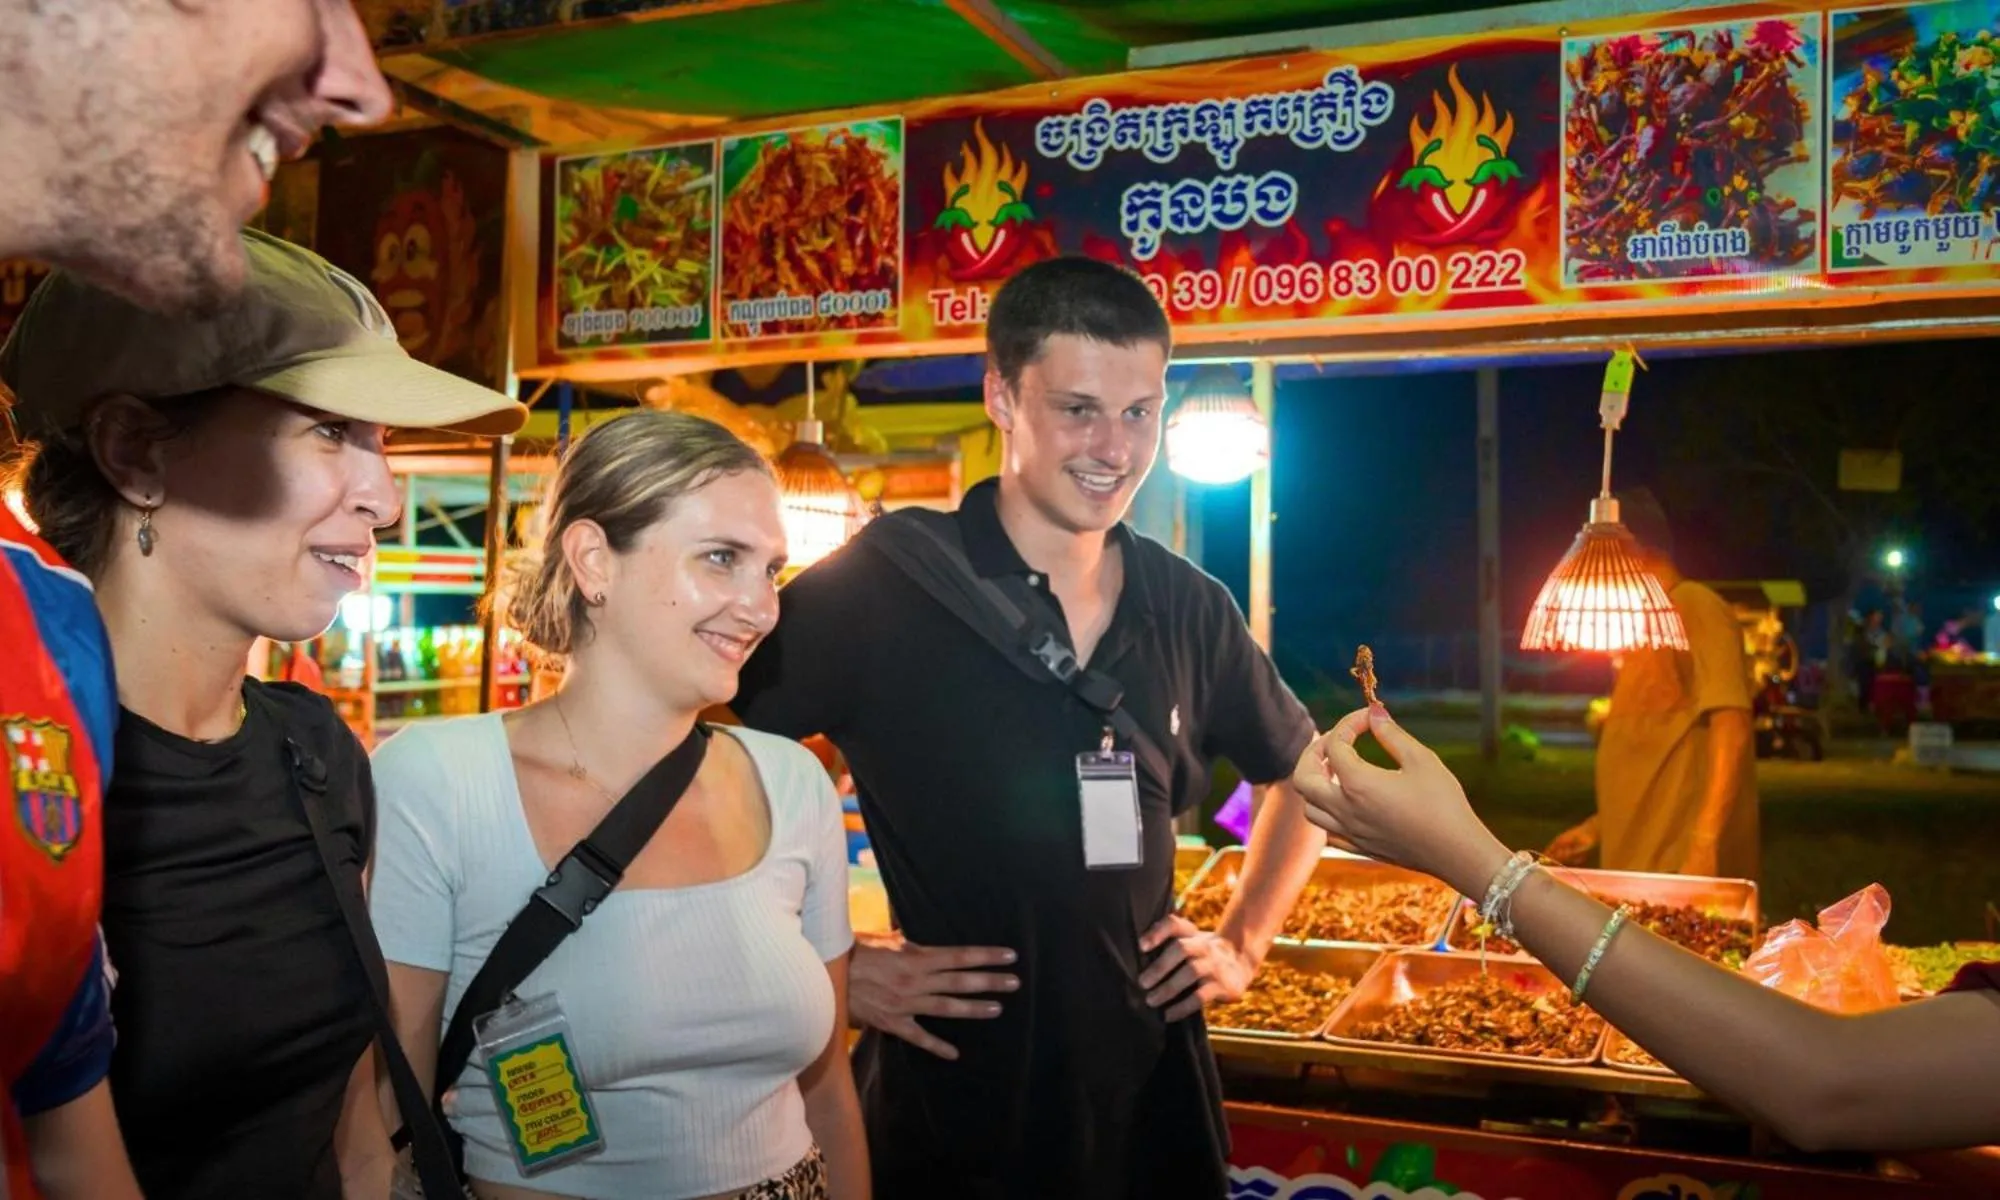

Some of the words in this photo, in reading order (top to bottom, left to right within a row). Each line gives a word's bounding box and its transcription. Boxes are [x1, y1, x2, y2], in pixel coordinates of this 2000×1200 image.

[1124, 175, 1293, 257] កូនបង
[930, 290, 988, 322] Tel:
[1176, 273, 1218, 307] 39
[1253, 266, 1320, 302] 096
[1332, 263, 1378, 297] 83
[1390, 257, 1437, 294] 00
[1450, 252, 1523, 290] 222
